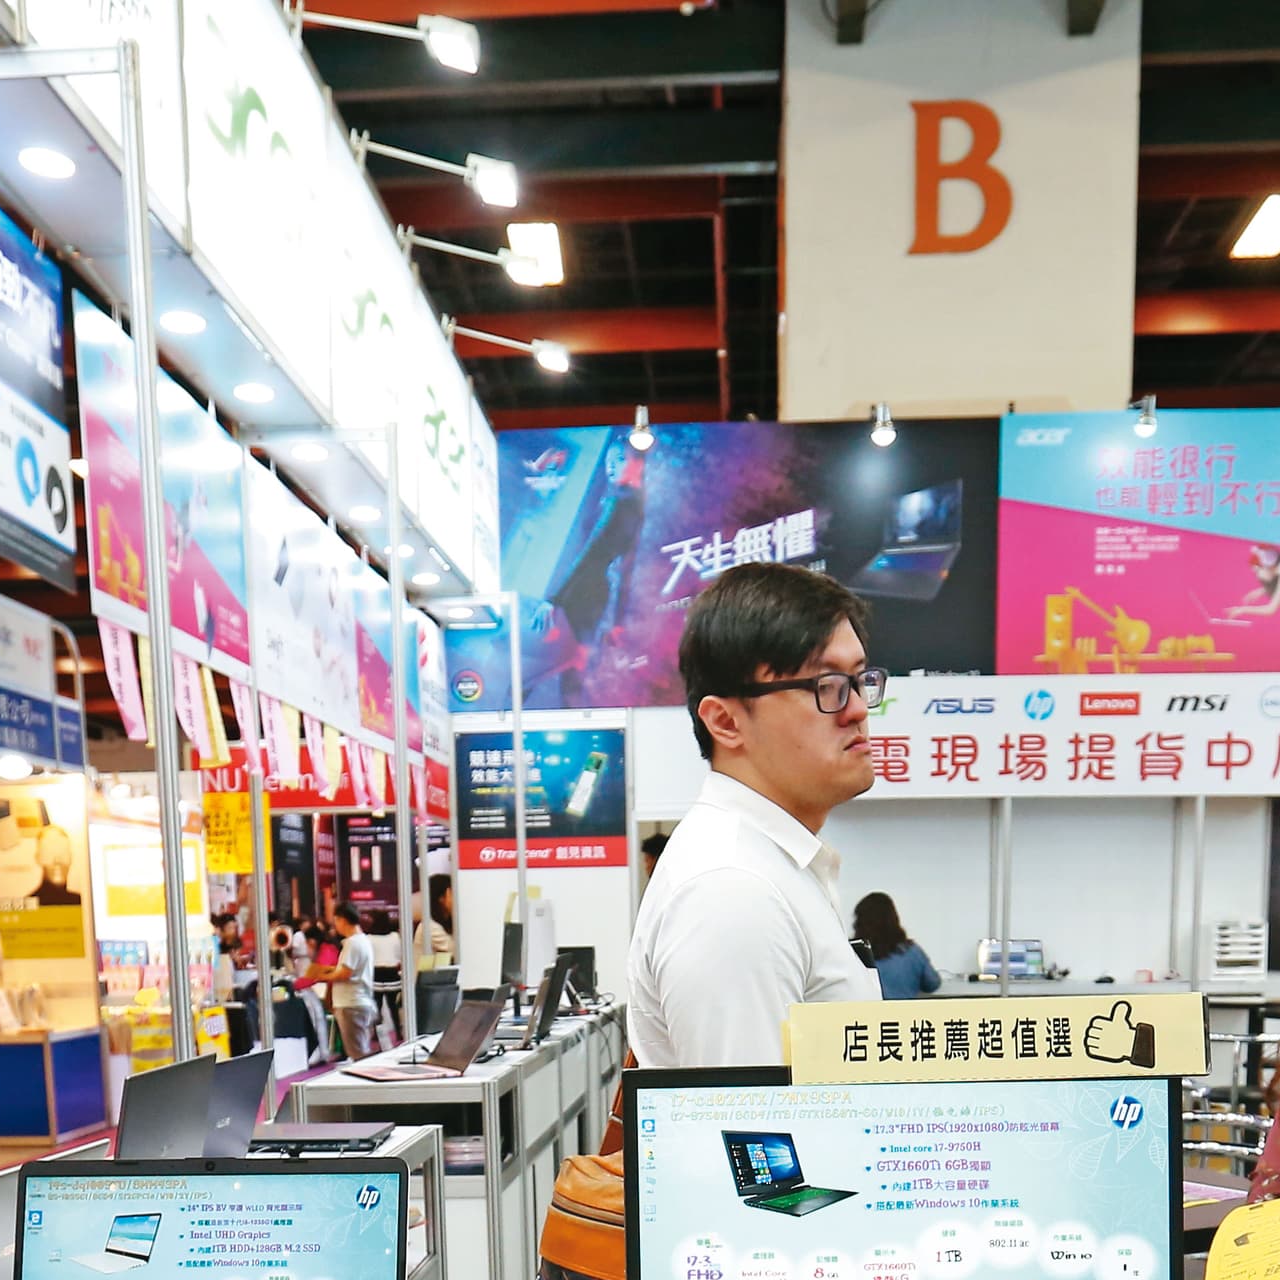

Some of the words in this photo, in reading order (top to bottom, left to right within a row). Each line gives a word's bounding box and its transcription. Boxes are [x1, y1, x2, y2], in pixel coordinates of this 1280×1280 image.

[907, 99, 1014, 255] B
[1016, 427, 1072, 446] acer
[923, 696, 996, 715] ASUS
[1024, 689, 1055, 720] hp
[1082, 695, 1139, 713] Lenovo
[1167, 693, 1230, 713] msi
[841, 1016, 1075, 1064] 店長推薦超值選
[1110, 1096, 1144, 1130] hp
[890, 1145, 911, 1153] Intel
[357, 1185, 381, 1210] hp
[190, 1231, 212, 1239] Intel
[215, 1231, 235, 1239] UHD
[303, 1244, 320, 1253] SSD
[946, 1250, 962, 1263] TB
[1051, 1251, 1076, 1260] Win
